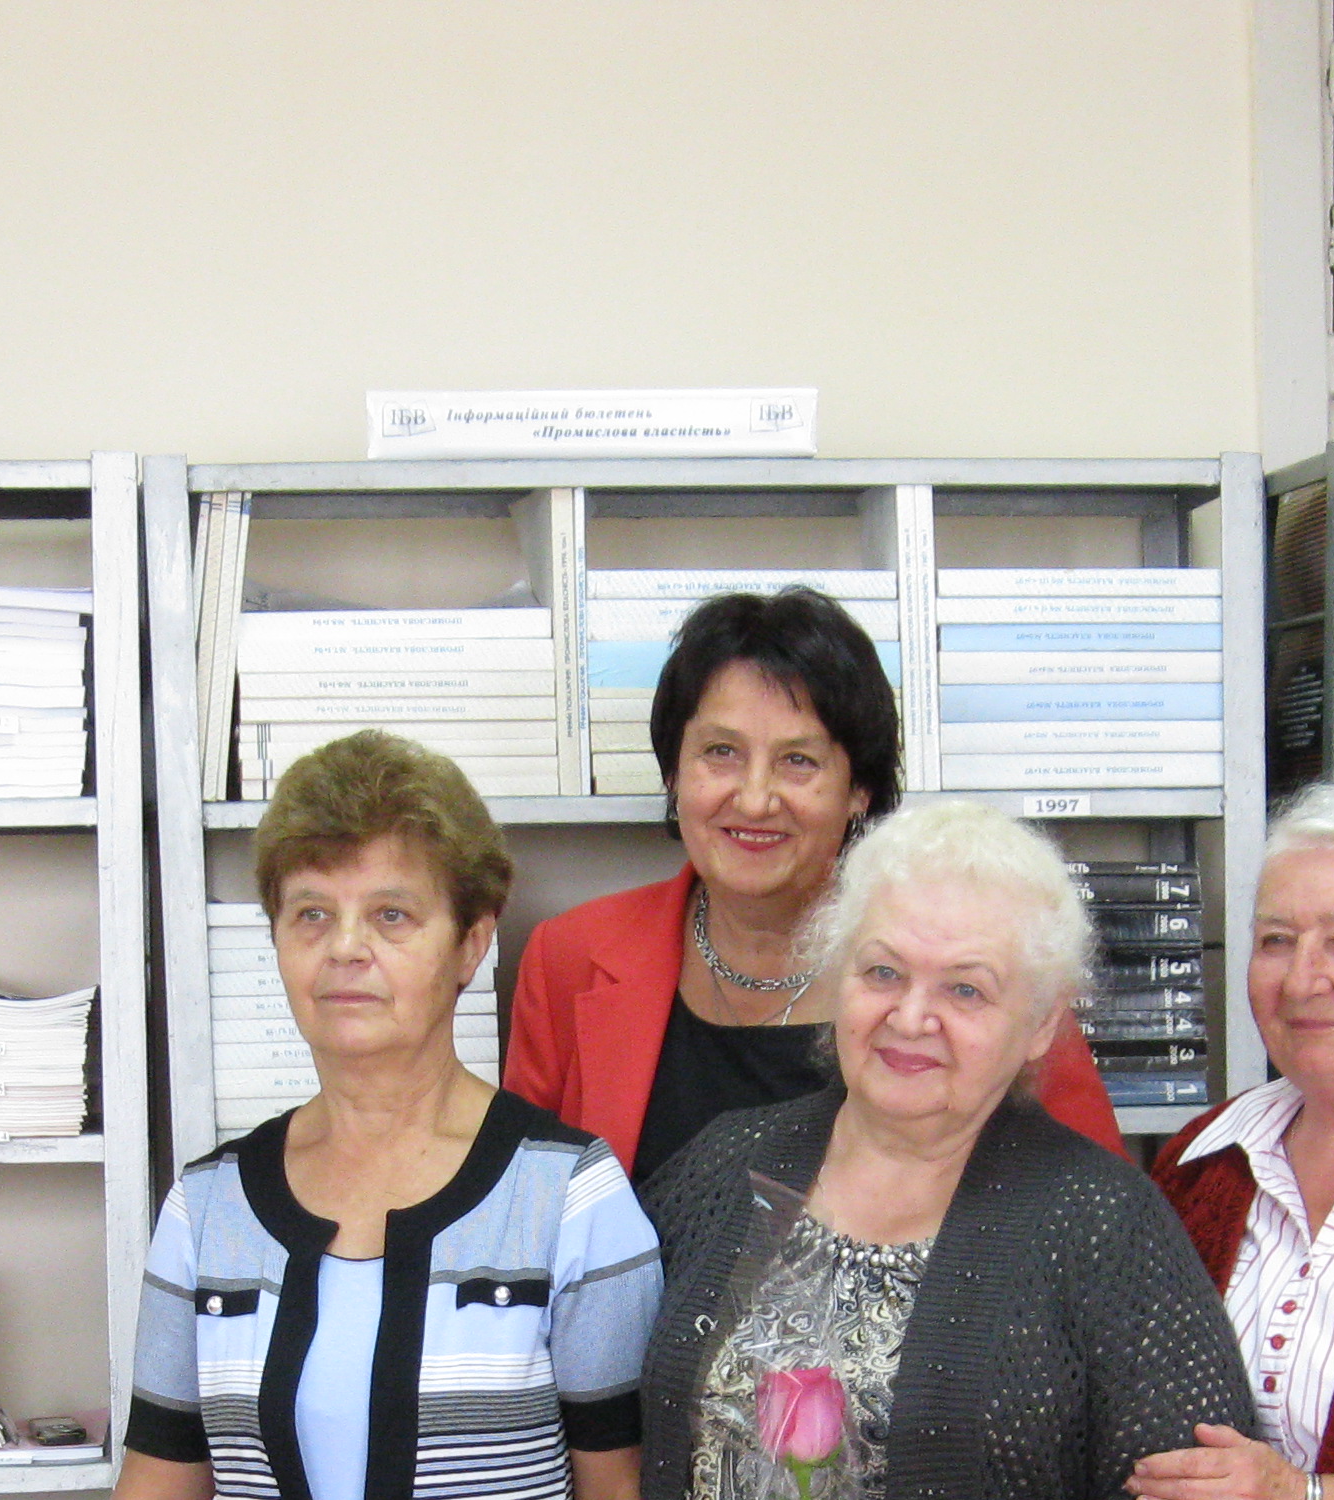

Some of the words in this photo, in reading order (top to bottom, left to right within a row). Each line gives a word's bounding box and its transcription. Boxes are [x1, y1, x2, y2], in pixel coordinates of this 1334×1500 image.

[446, 407, 569, 424] Інформаційний
[575, 408, 652, 421] бюлетень
[1034, 798, 1079, 812] 1997
[1170, 885, 1190, 899] 7
[1170, 917, 1188, 931] 6
[1170, 961, 1192, 976] 5
[1175, 991, 1192, 1004] 4
[1176, 1018, 1193, 1032] 4
[1179, 1048, 1195, 1061] 3
[1177, 1083, 1198, 1095] 1
